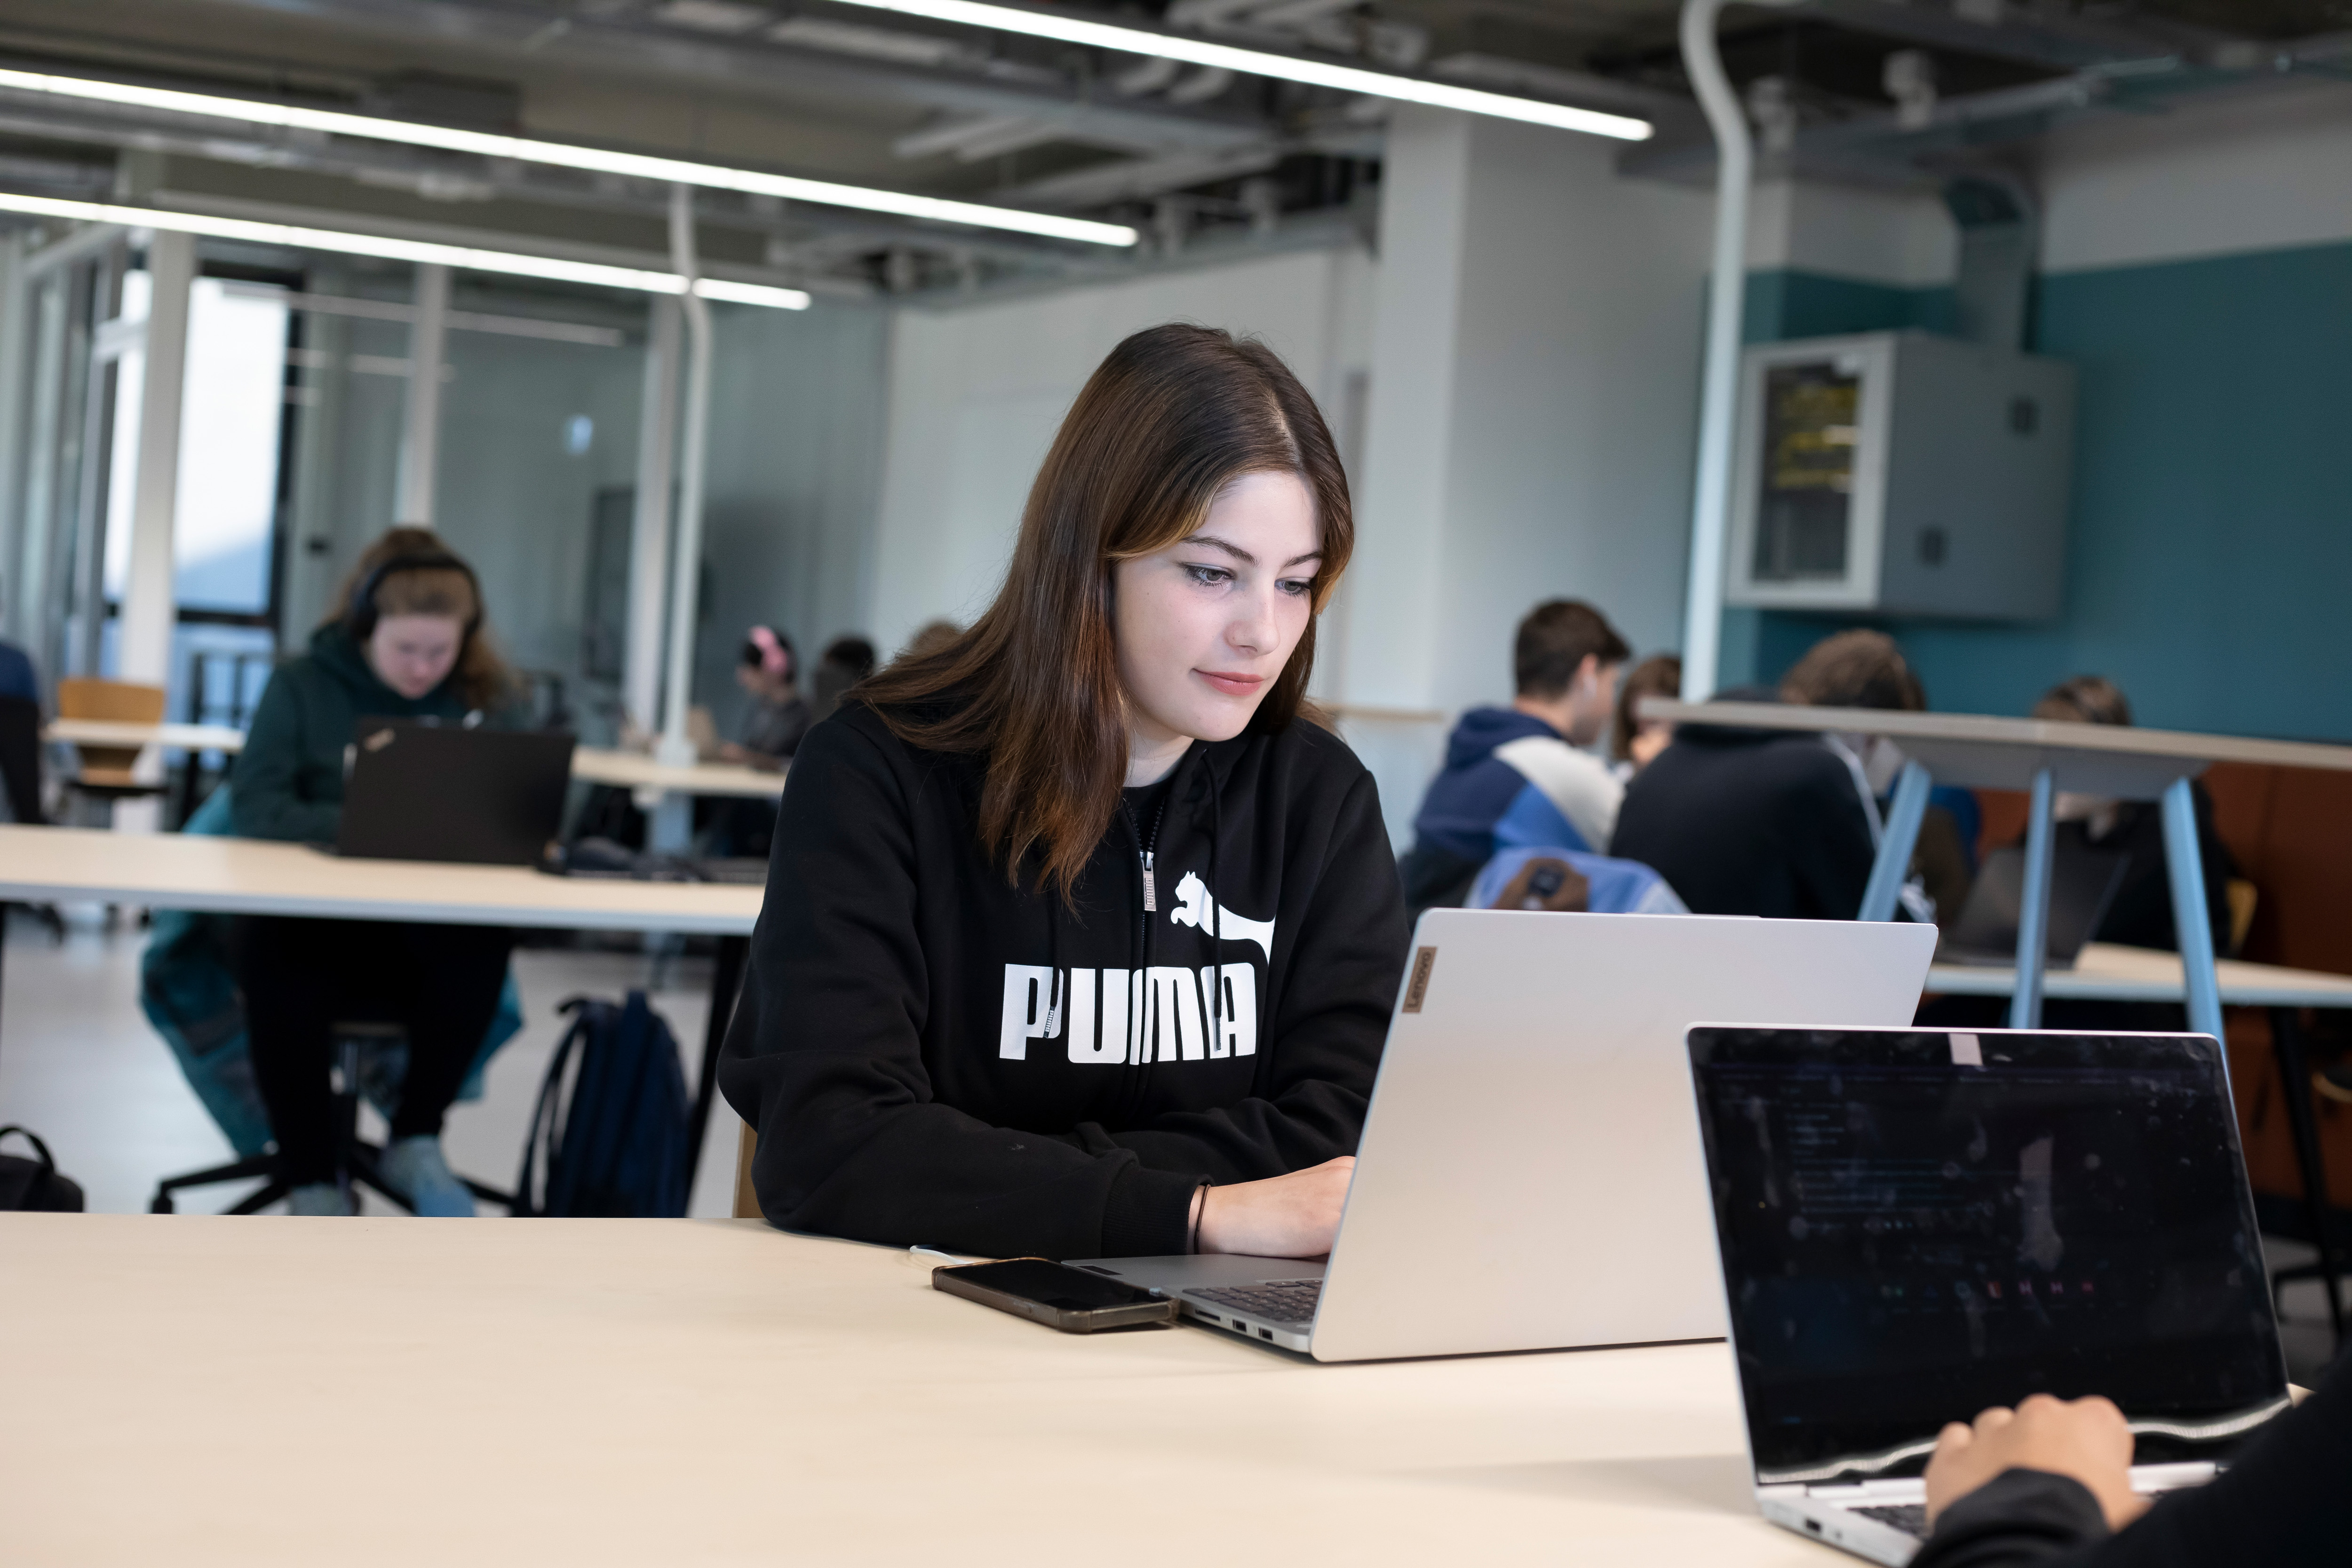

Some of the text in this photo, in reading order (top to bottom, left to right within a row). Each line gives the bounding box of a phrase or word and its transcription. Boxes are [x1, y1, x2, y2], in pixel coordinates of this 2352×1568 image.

[1144, 878, 1154, 905] PUMA
[1406, 951, 1431, 1008] Lenovo
[1000, 962, 1256, 1065] PUMA
